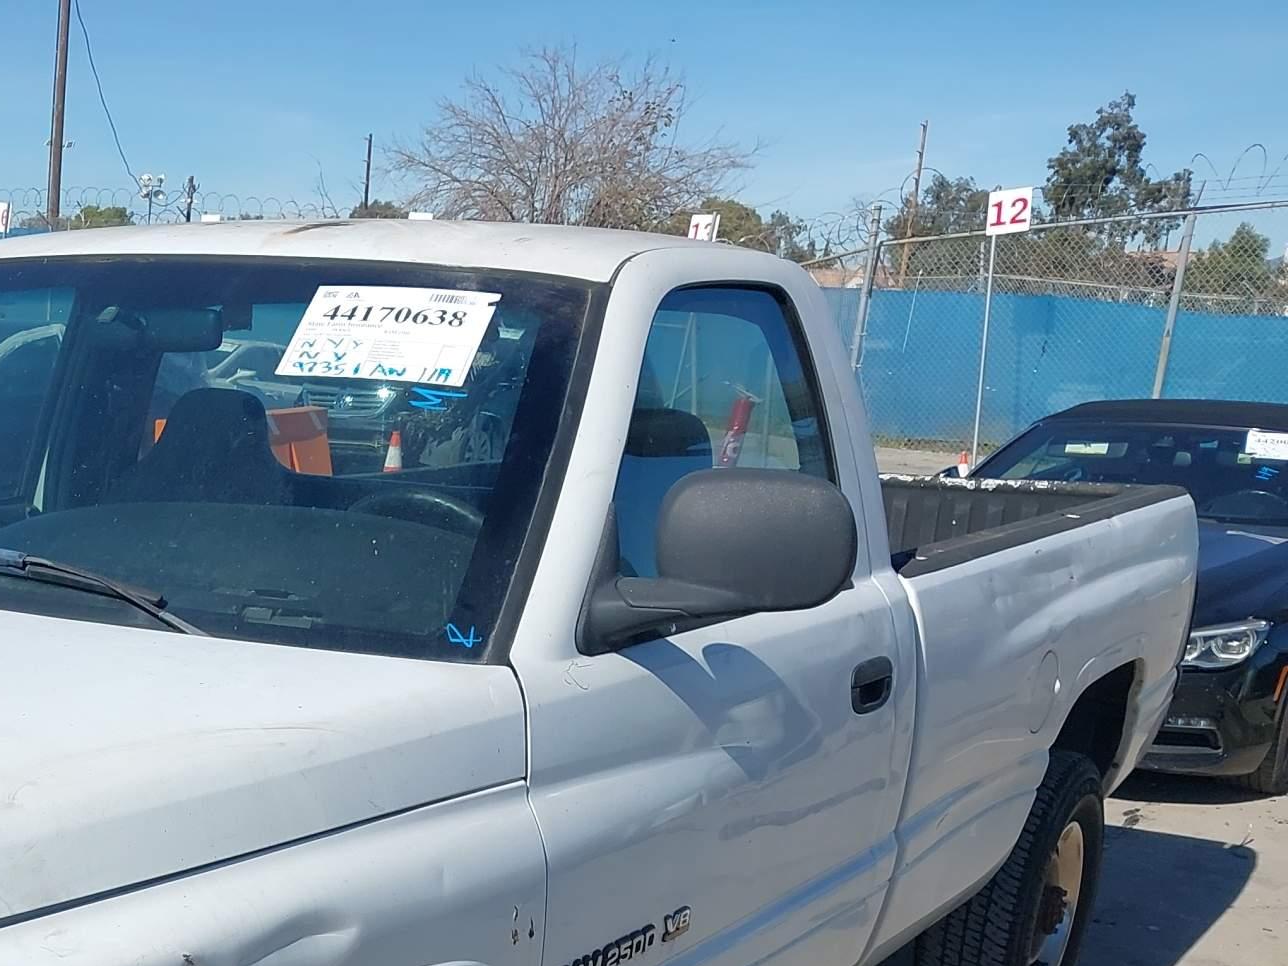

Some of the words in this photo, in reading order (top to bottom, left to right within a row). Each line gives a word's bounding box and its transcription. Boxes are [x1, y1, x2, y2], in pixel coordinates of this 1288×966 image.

[989, 197, 1029, 227] 12
[323, 304, 468, 328] 44170638
[662, 906, 692, 942] V8
